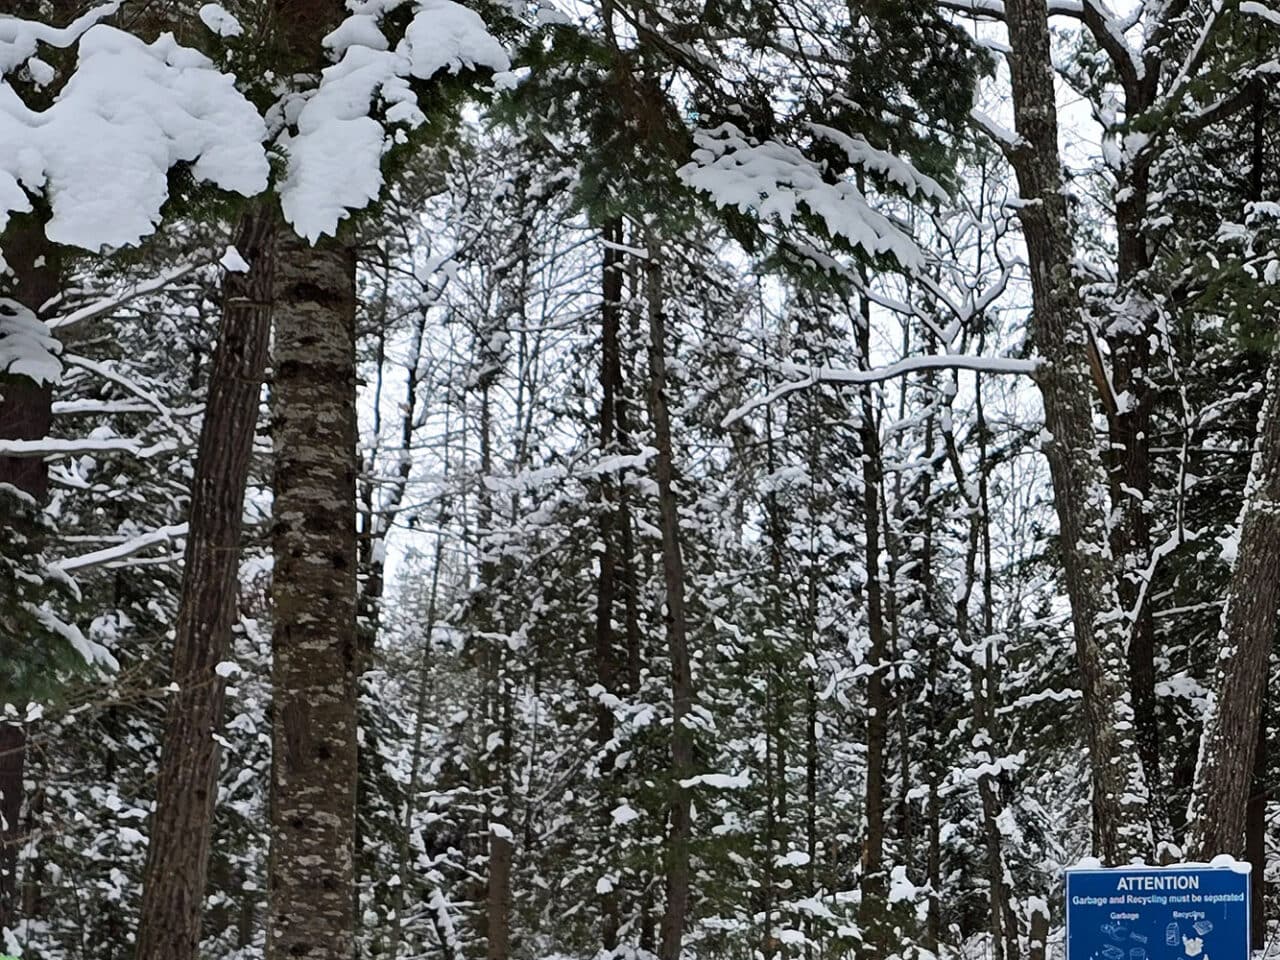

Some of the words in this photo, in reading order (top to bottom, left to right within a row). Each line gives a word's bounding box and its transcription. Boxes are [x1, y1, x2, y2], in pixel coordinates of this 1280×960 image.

[1117, 875, 1199, 891] ATTENTION
[1072, 896, 1107, 907] Garbage
[1109, 895, 1125, 904] and
[1127, 894, 1167, 905] Recycling
[1169, 894, 1190, 903] must
[1191, 893, 1202, 902] be
[1204, 892, 1244, 904] separated
[1110, 912, 1139, 921] Garbage
[1173, 910, 1205, 920] Recycling
